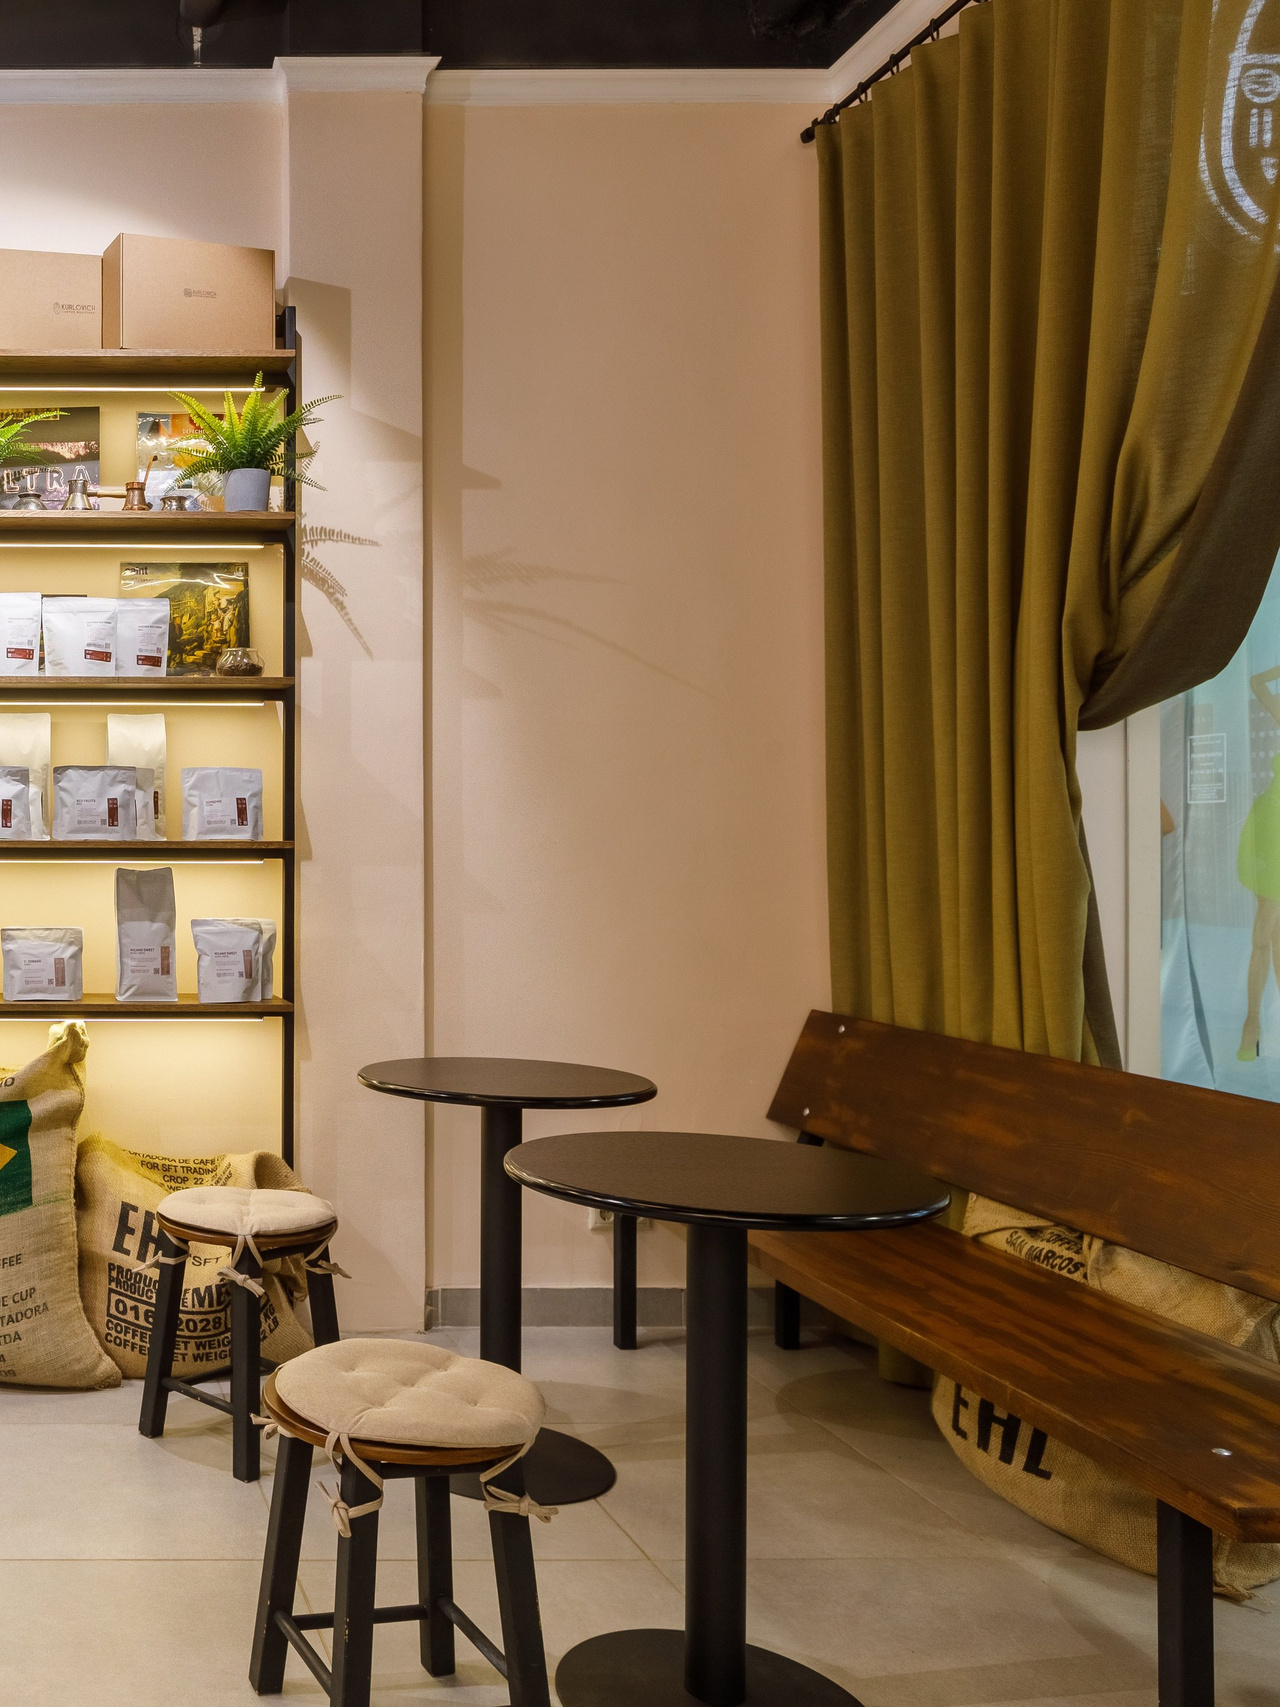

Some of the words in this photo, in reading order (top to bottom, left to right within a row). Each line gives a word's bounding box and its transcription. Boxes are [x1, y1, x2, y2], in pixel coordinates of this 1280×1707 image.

[140, 1160, 160, 1171] FOR
[161, 1163, 179, 1174] SFT
[180, 1165, 218, 1176] TRADING
[163, 1174, 189, 1185] CROP
[193, 1177, 204, 1185] 22
[1005, 1230, 1028, 1256] SAN
[1025, 1245, 1086, 1275] MARCOS
[12, 1287, 36, 1304] CUP
[177, 1317, 220, 1334] 2028
[268, 1317, 279, 1334] LB
[105, 1332, 149, 1356] COFFE
[173, 1352, 188, 1363] ET
[192, 1350, 231, 1361] WEIG
[174, 1340, 191, 1351] ET
